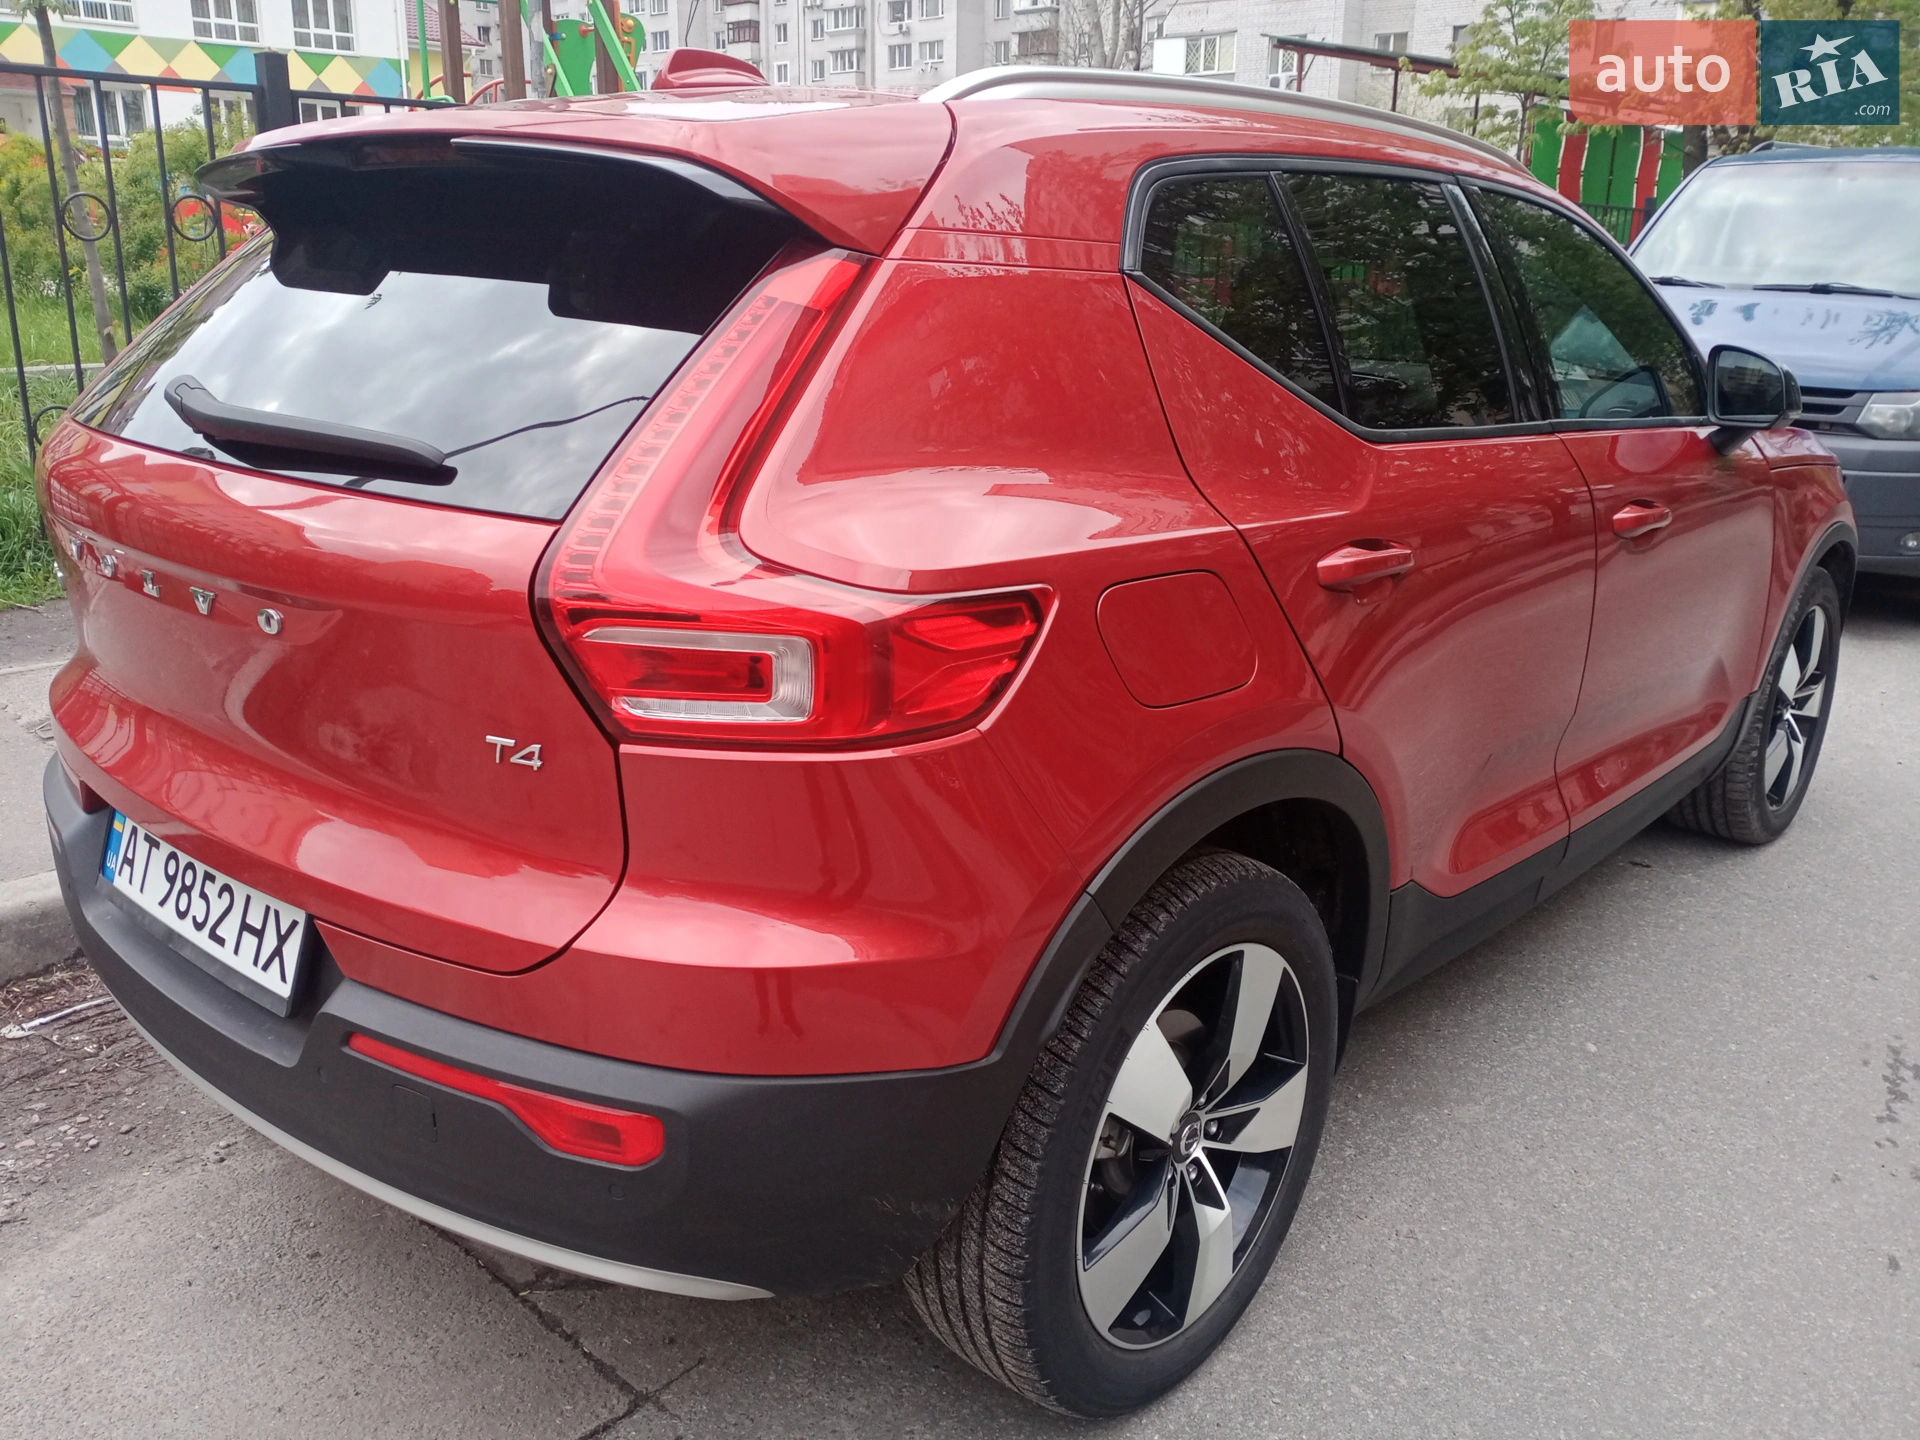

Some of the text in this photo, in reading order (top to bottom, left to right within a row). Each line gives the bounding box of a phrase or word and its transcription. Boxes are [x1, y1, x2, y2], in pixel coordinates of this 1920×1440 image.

[69, 537, 284, 635] VOLVO
[485, 735, 544, 771] T4
[106, 850, 116, 874] UA
